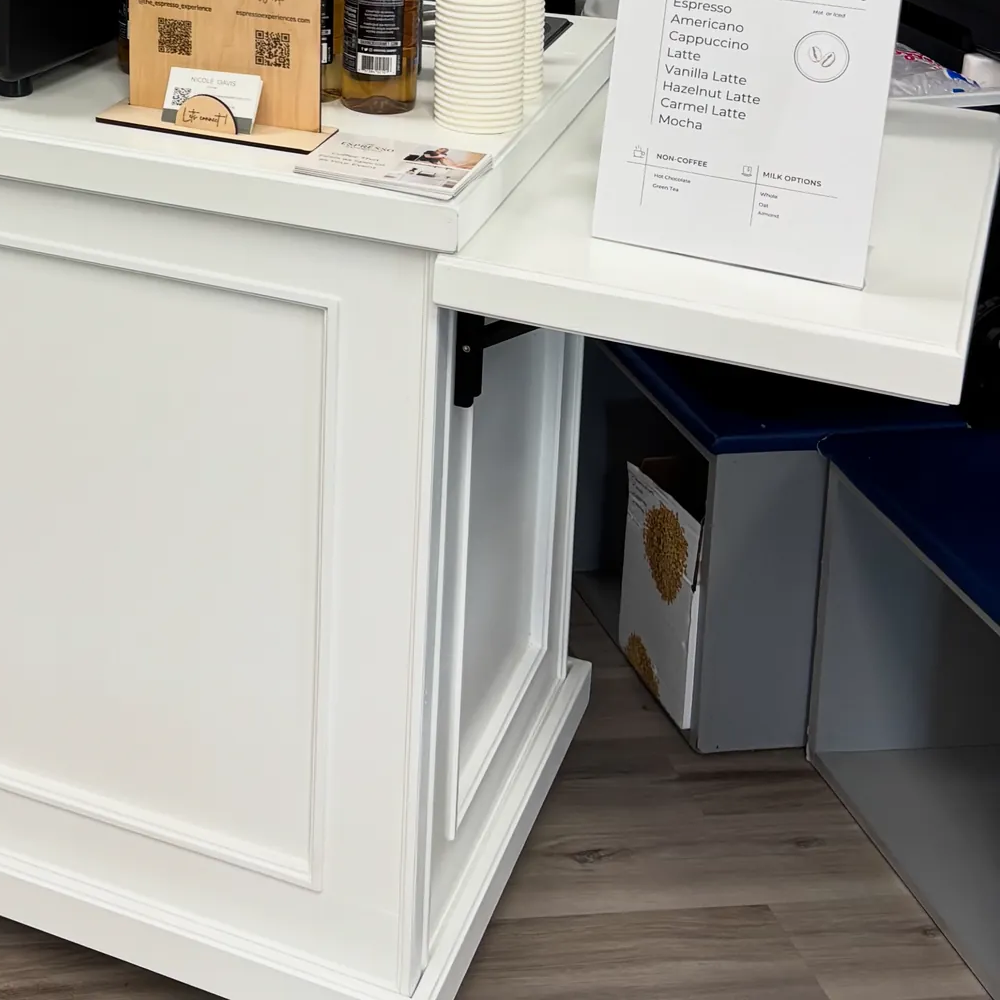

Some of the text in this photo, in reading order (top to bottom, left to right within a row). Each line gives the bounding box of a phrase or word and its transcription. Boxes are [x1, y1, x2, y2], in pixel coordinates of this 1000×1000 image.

[670, 13, 744, 33] Americano
[668, 30, 749, 51] Cappuccino
[667, 47, 701, 62] Latte
[190, 76, 215, 85] NICOLE
[664, 63, 747, 86] Vanilla Latte
[662, 80, 761, 105] Hazelnut Latte
[660, 97, 747, 120] Carmel Latte
[658, 113, 703, 130] Mocha
[656, 153, 708, 168] NON-COFFEE
[652, 183, 669, 191] Green
[664, 174, 691, 184] Chocolate
[762, 171, 822, 188] MILK OPTIONS
[759, 191, 778, 199] Whole
[757, 210, 780, 219] Almond
